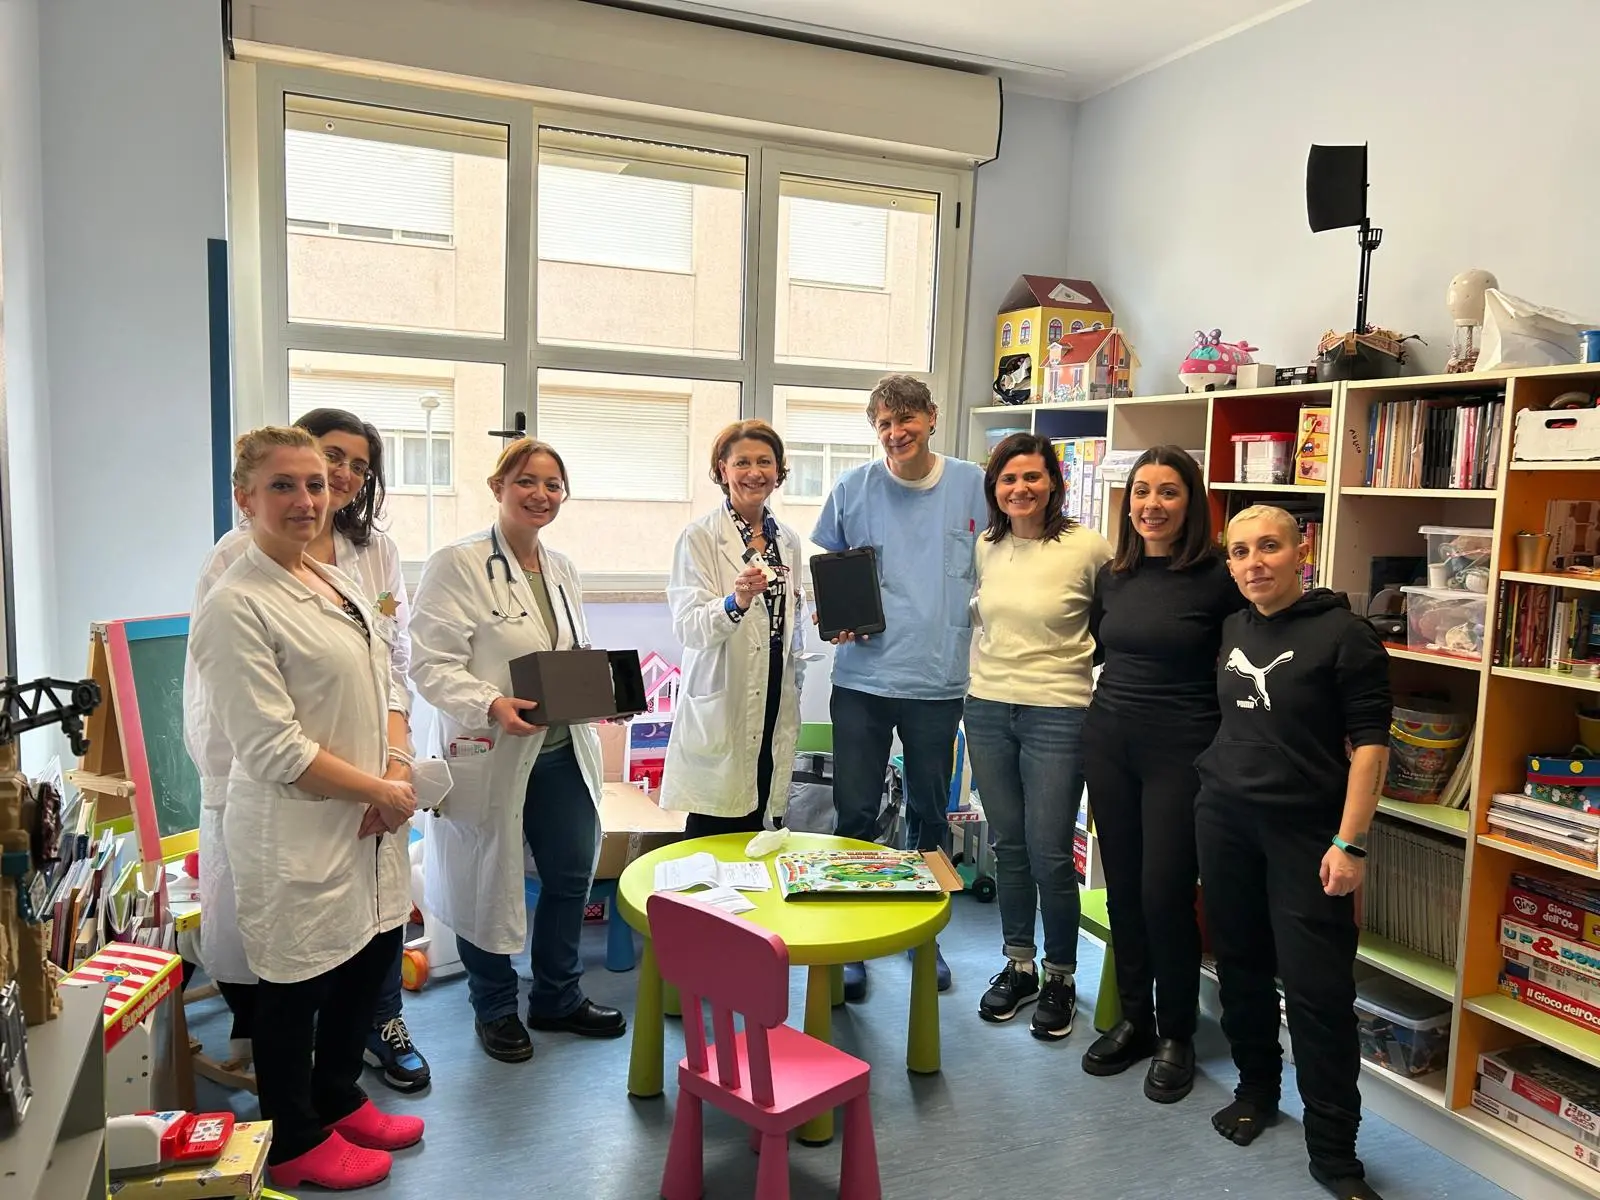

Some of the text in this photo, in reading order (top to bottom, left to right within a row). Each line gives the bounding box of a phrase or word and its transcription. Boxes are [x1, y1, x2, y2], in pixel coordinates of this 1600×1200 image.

[1514, 897, 1537, 914] Bing
[1547, 903, 1573, 918] Gioco
[1542, 912, 1579, 931] dell'Oca
[1503, 927, 1533, 944] UP
[1531, 936, 1560, 960] &
[1526, 988, 1533, 998] Il
[1534, 991, 1562, 1009] Gioco
